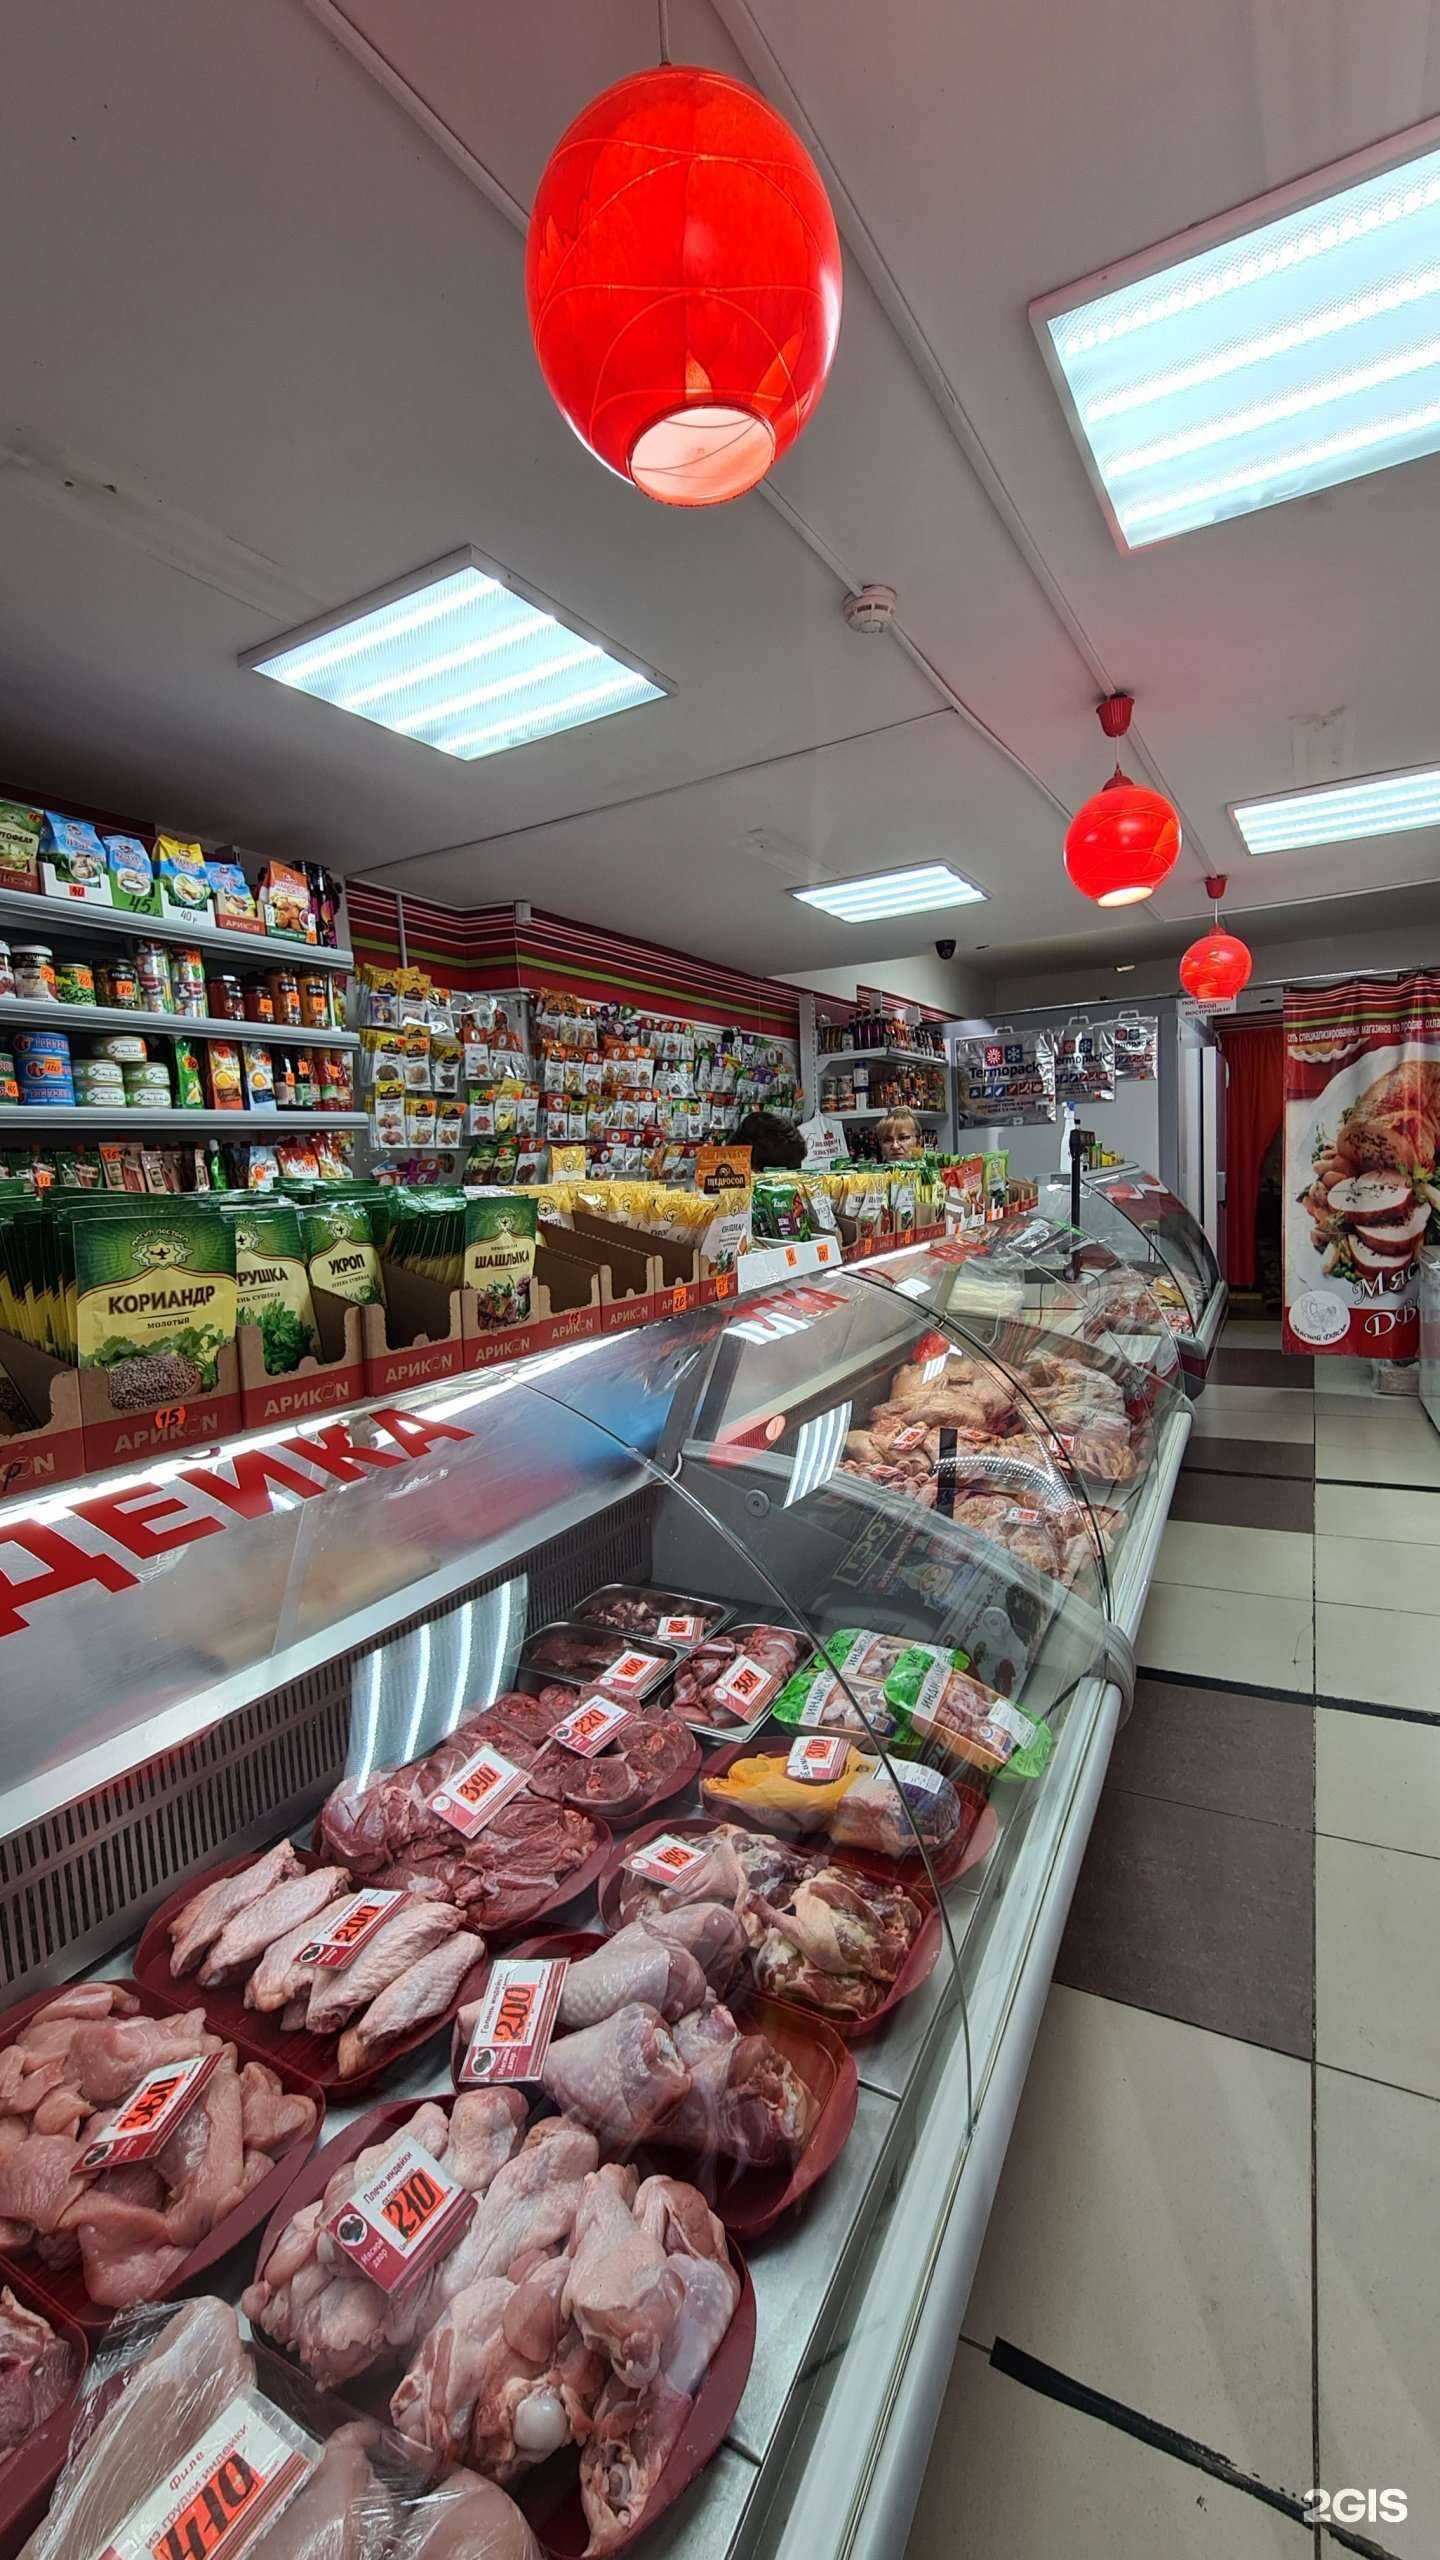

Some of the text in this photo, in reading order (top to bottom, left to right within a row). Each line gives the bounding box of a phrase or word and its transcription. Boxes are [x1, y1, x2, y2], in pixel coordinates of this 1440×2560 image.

[128, 895, 152, 913] 45
[179, 909, 192, 921] 40
[970, 1063, 1041, 1079] Termopack
[328, 1254, 365, 1275] УКРОП
[474, 1249, 529, 1269] ШАШЛЫКА
[108, 1285, 216, 1315] КОРИАНДР
[159, 1407, 181, 1427] 15
[732, 1668, 760, 1695] 360
[574, 1708, 608, 1735] 220
[456, 1765, 498, 1802] 390
[333, 1904, 381, 1942] 200
[494, 1986, 531, 2040] 200
[363, 2151, 414, 2205] Плечо индейки
[386, 2172, 436, 2240] 210
[169, 2449, 206, 2492] Филе
[144, 2423, 250, 2551] из грудки индейки
